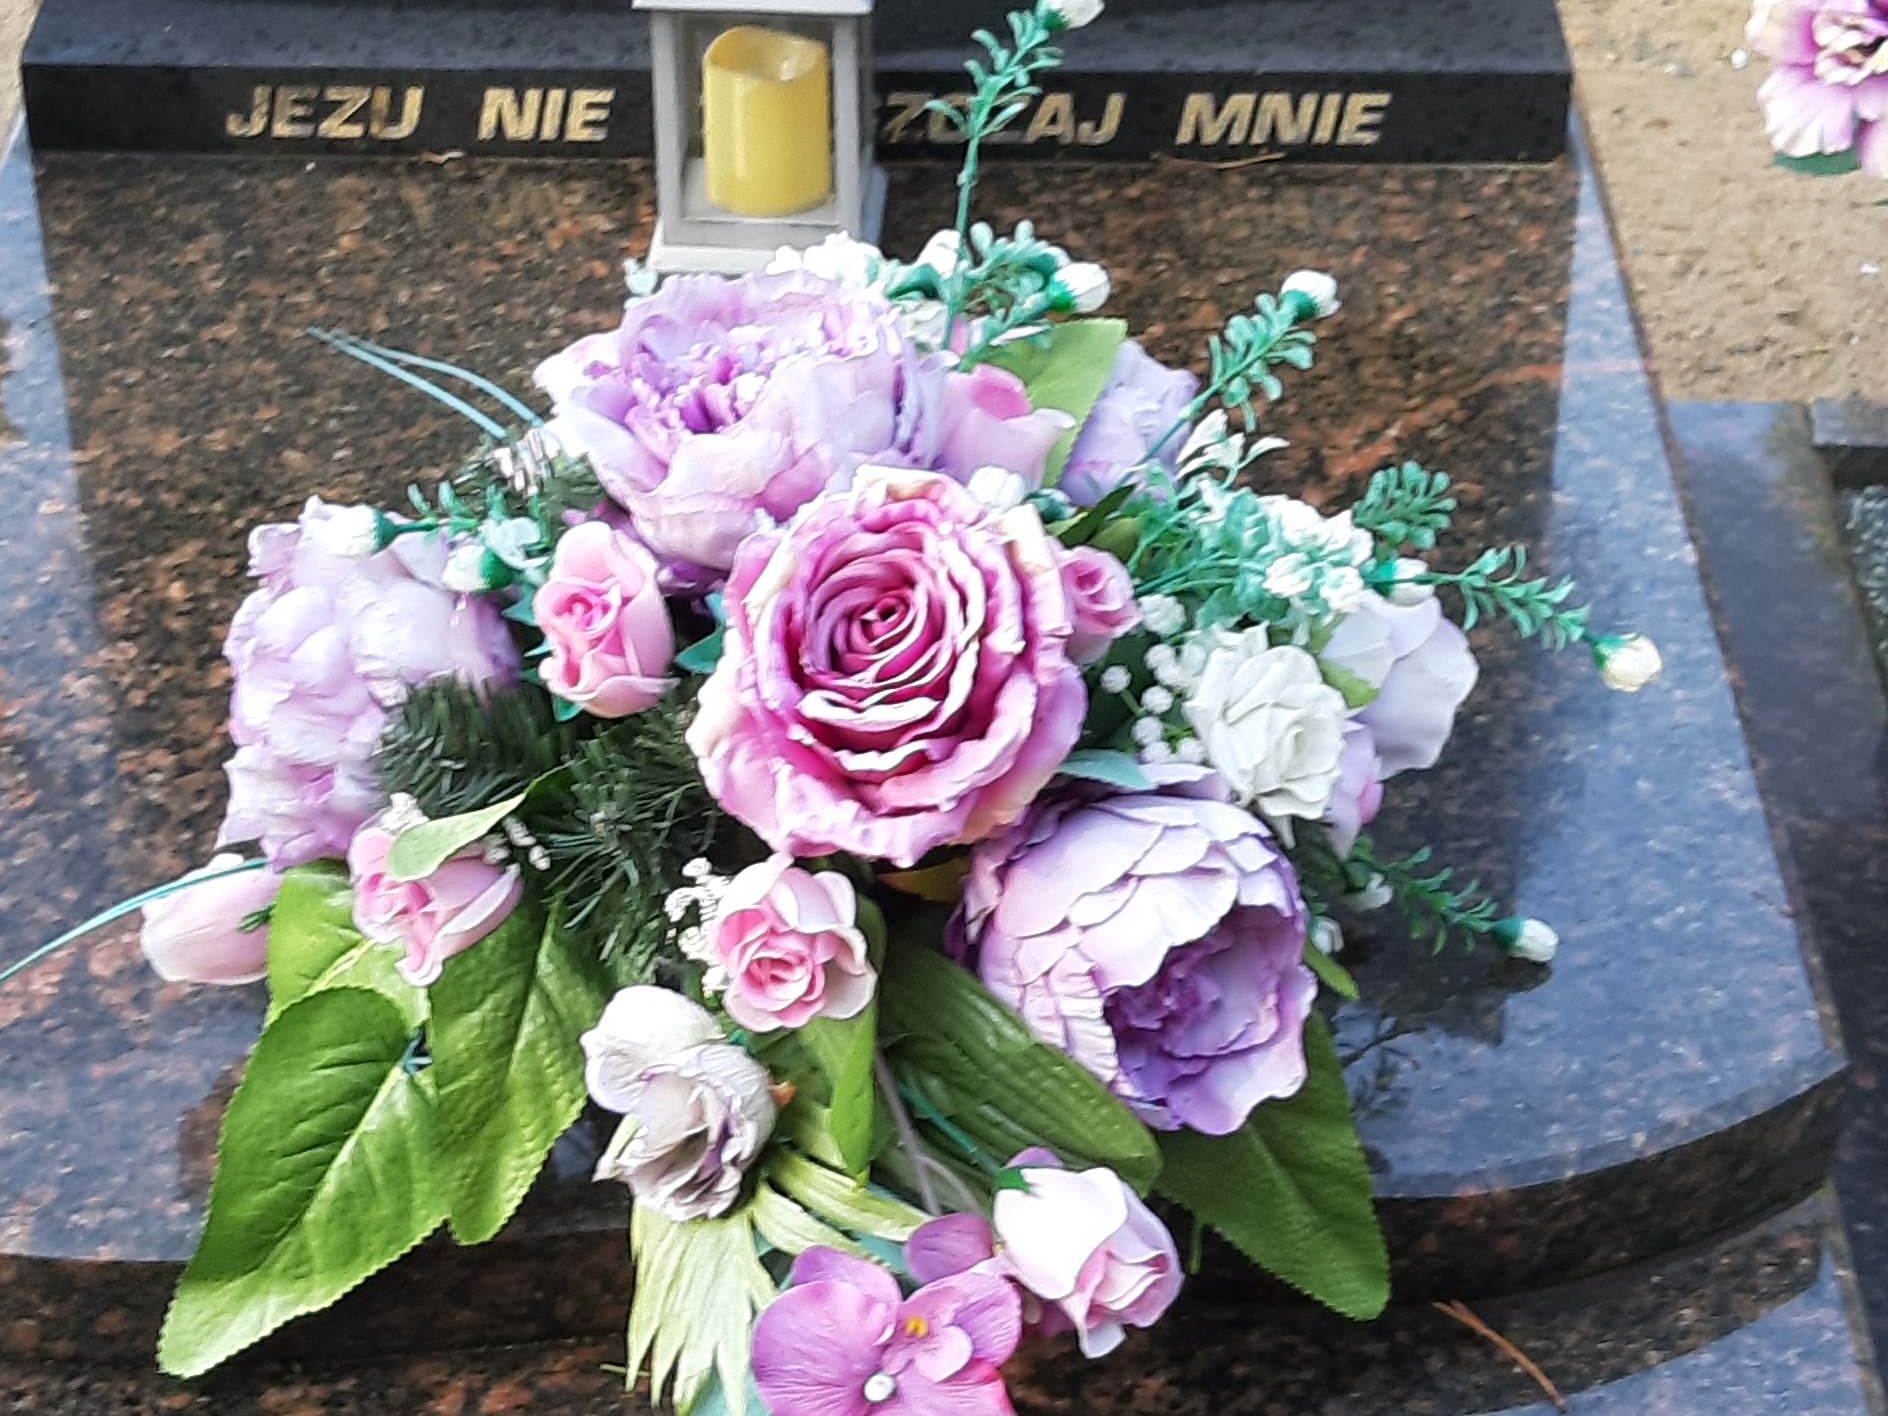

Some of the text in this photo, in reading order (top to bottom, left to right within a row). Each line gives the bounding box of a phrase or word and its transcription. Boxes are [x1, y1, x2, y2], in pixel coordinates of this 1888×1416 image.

[225, 85, 426, 140] JEZU
[477, 86, 616, 142] NIE
[1174, 91, 1393, 147] MNIE
